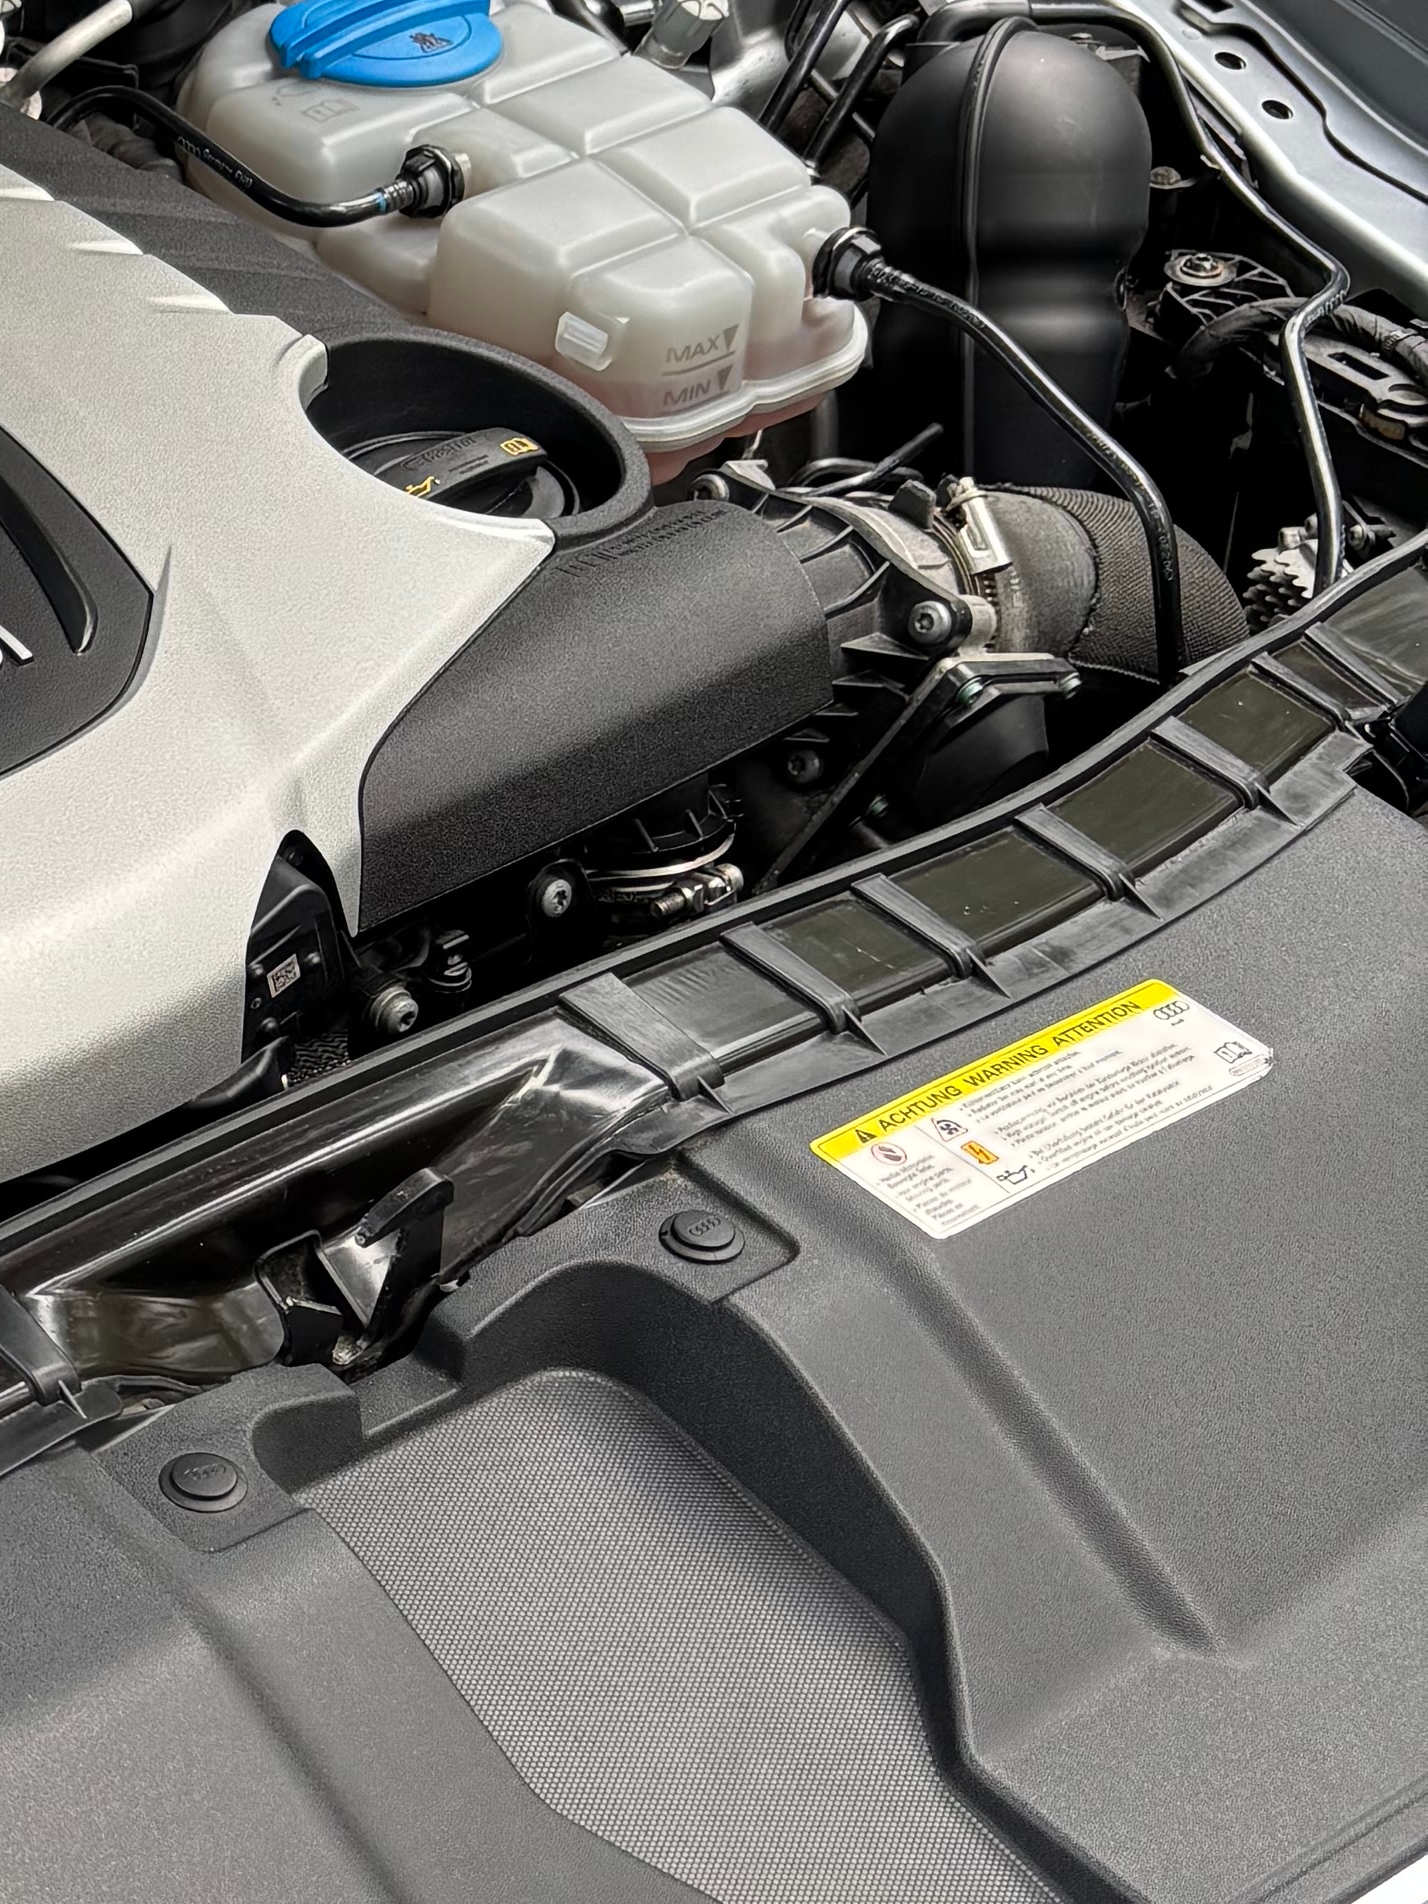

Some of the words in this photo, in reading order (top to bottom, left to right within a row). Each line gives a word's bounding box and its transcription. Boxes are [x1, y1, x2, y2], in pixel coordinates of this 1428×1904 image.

[665, 334, 721, 364] MAX
[663, 380, 712, 407] MIN
[878, 1084, 962, 1133] ACHTUNG
[968, 1043, 1048, 1088] WARNING
[1051, 1000, 1143, 1047] ATTENTION
